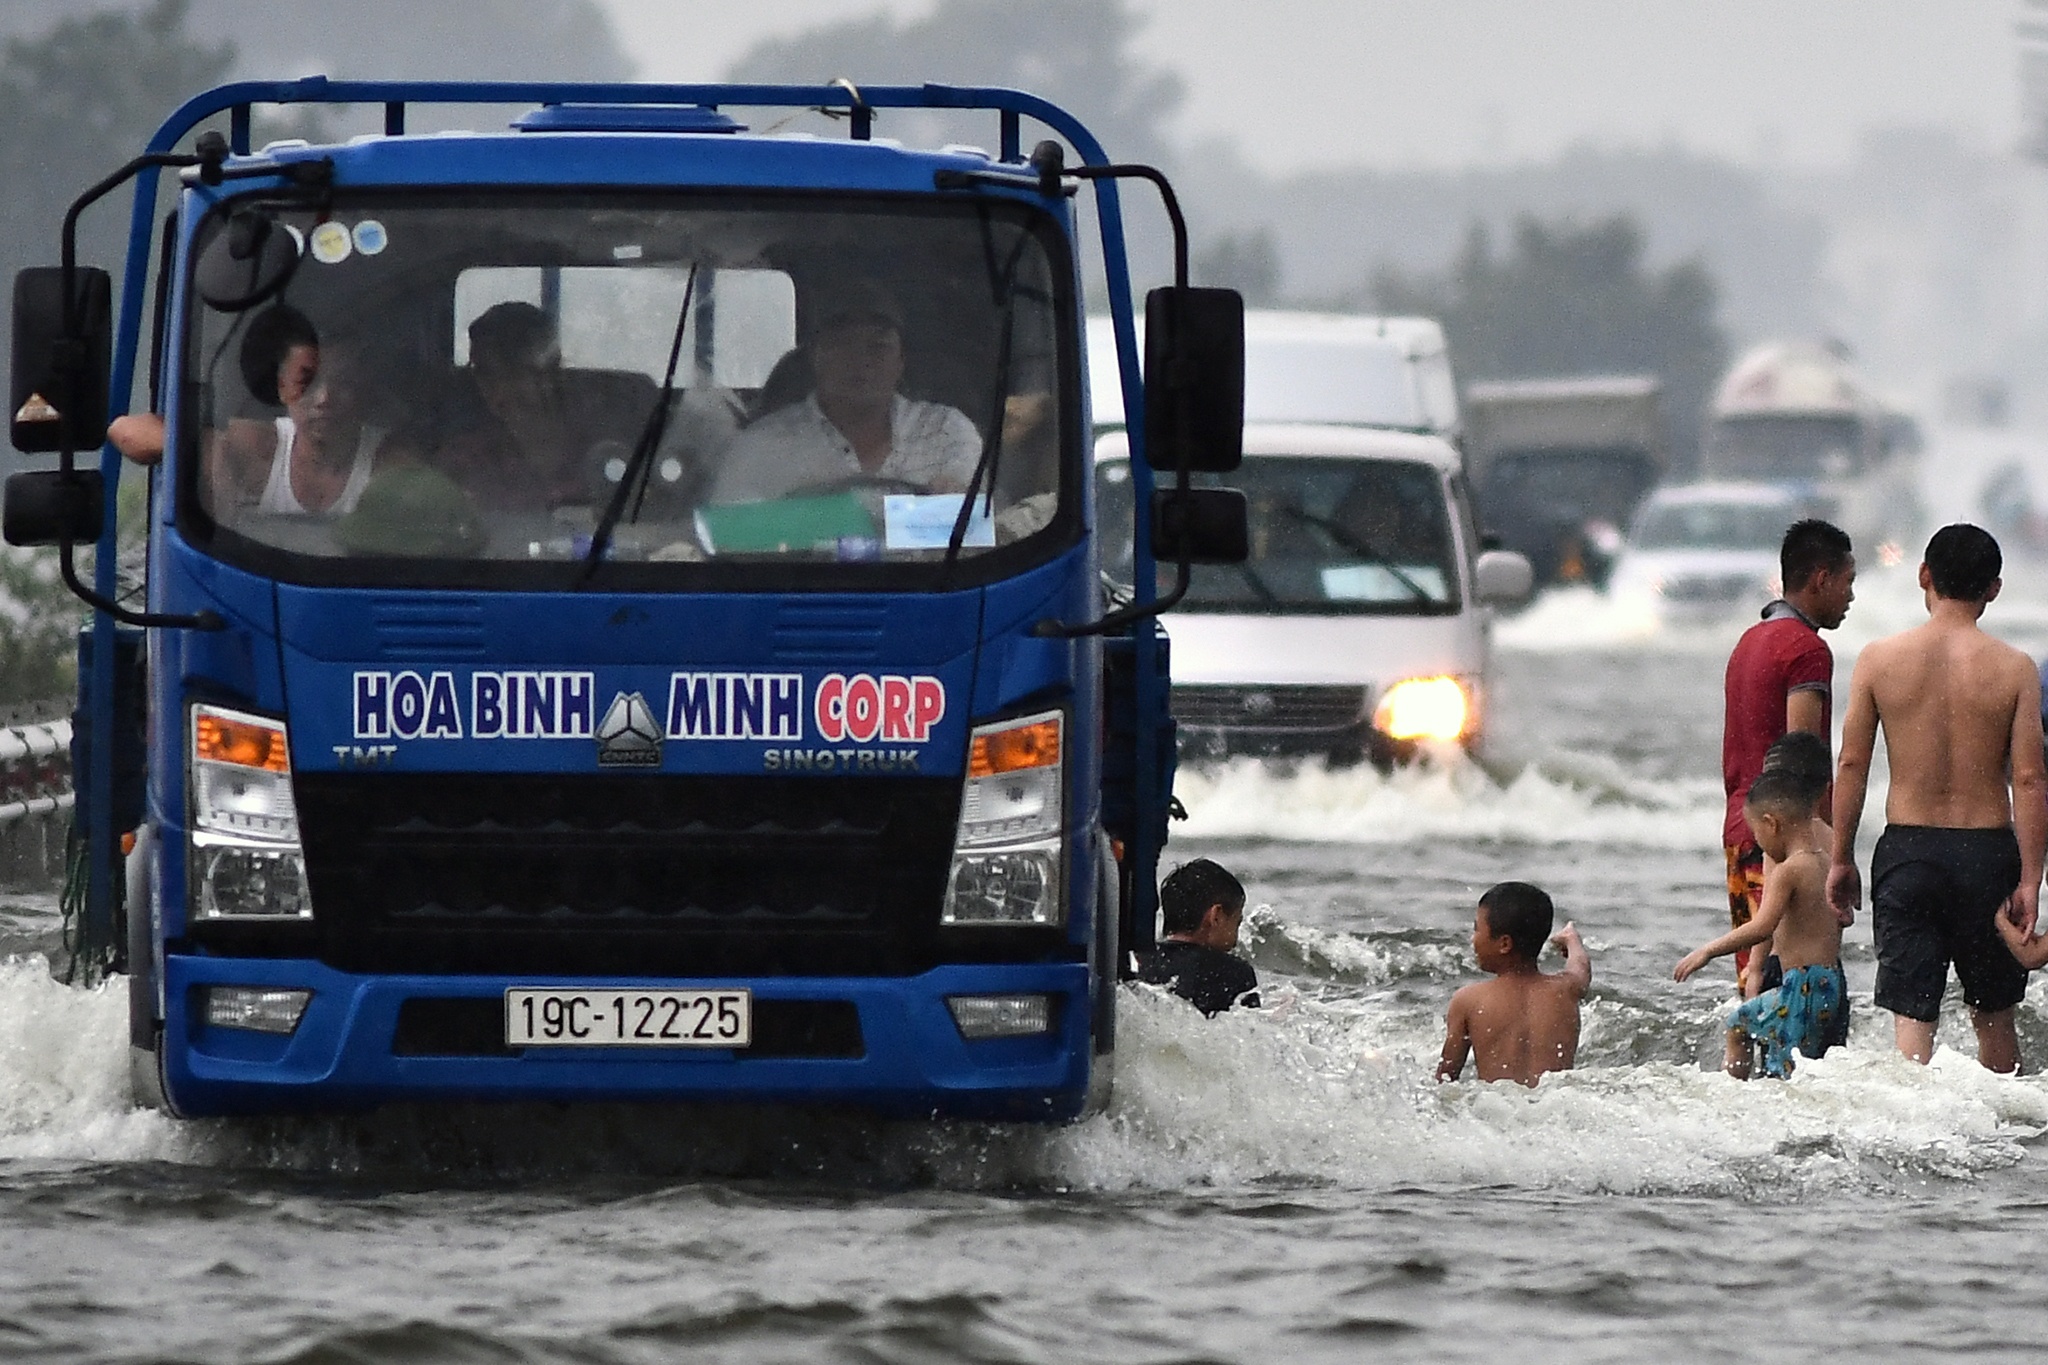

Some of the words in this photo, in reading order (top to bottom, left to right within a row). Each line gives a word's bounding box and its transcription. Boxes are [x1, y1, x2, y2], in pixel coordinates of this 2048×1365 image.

[353, 671, 461, 739] HOA
[472, 671, 595, 739] BINH
[667, 673, 803, 740] MINH
[815, 674, 946, 742] CORP
[332, 745, 398, 766] TMT
[764, 749, 919, 770] SINOTRUK
[522, 997, 740, 1038] 19C-122.25
